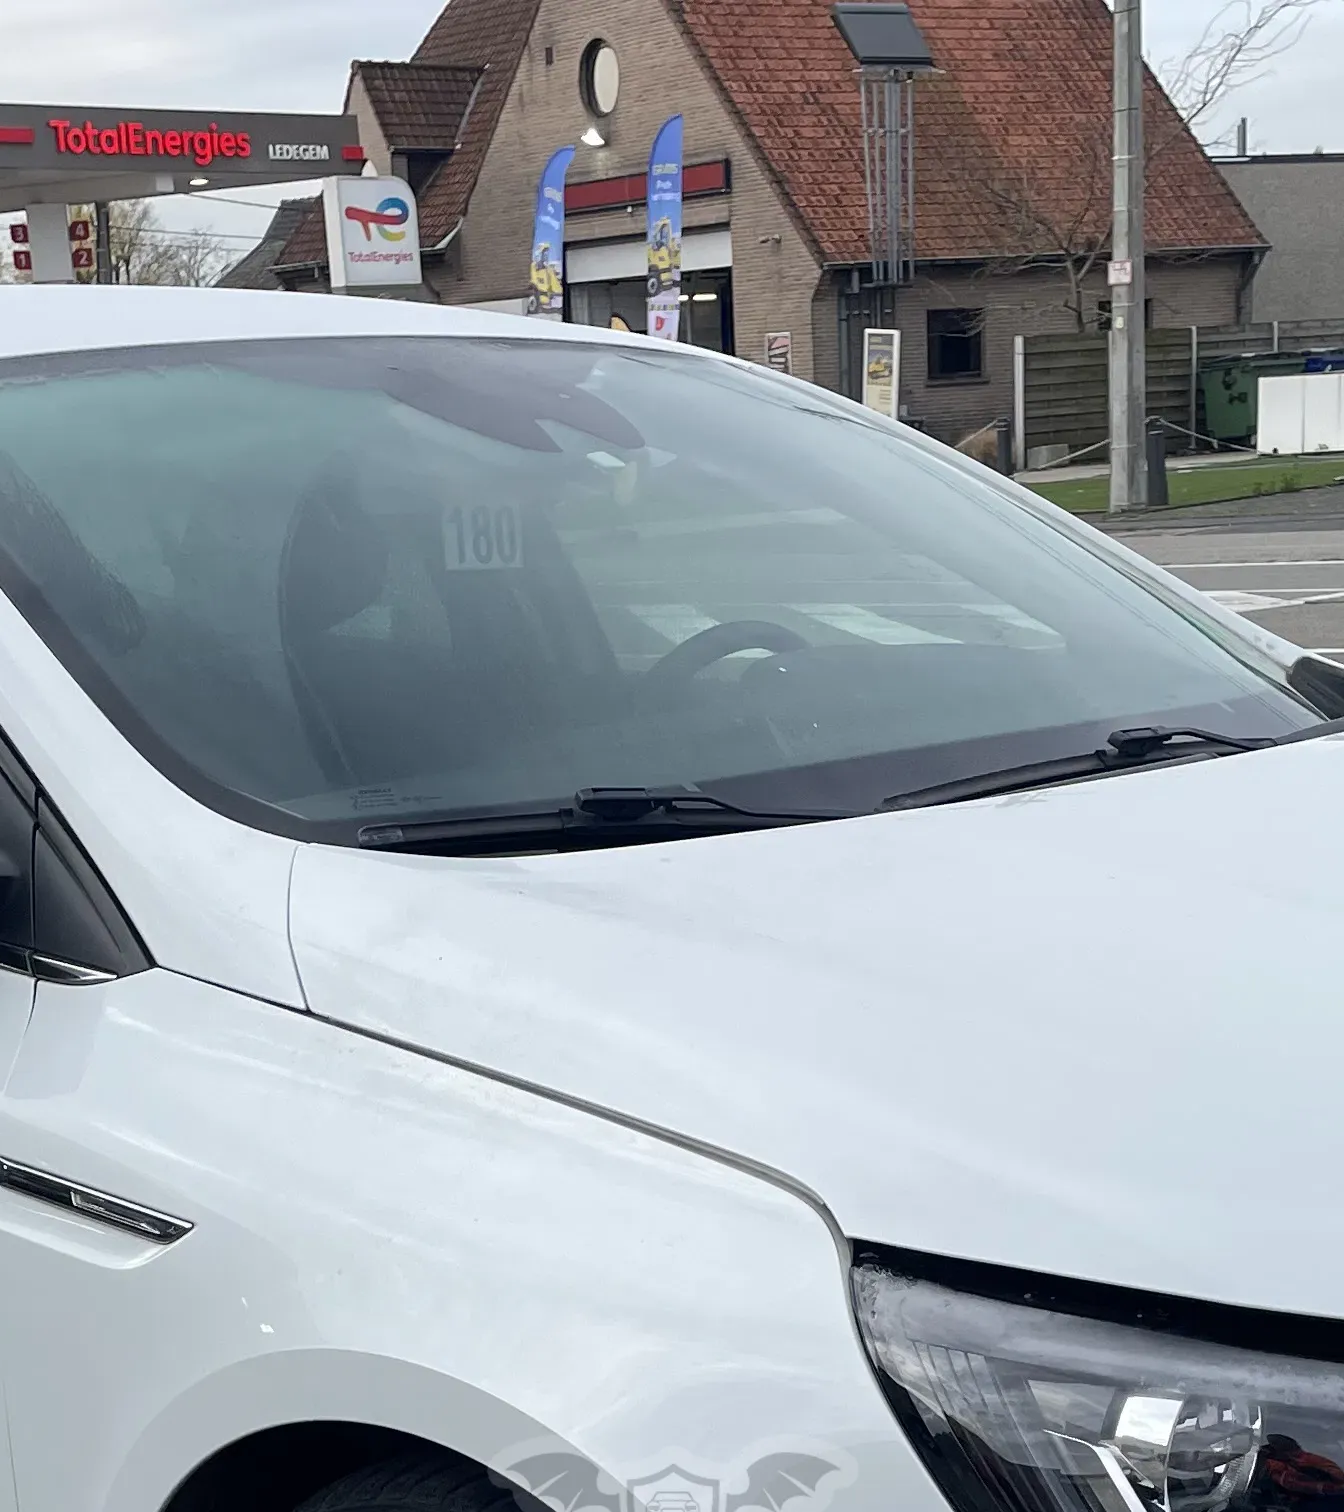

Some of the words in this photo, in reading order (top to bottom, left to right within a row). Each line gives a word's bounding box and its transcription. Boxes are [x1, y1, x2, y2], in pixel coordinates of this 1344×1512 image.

[48, 119, 251, 166] TotalEnergies
[268, 143, 330, 160] LEDEGEM
[15, 227, 25, 241] 3
[76, 223, 85, 237] 4
[79, 251, 89, 265] 2
[446, 503, 518, 565] 180
